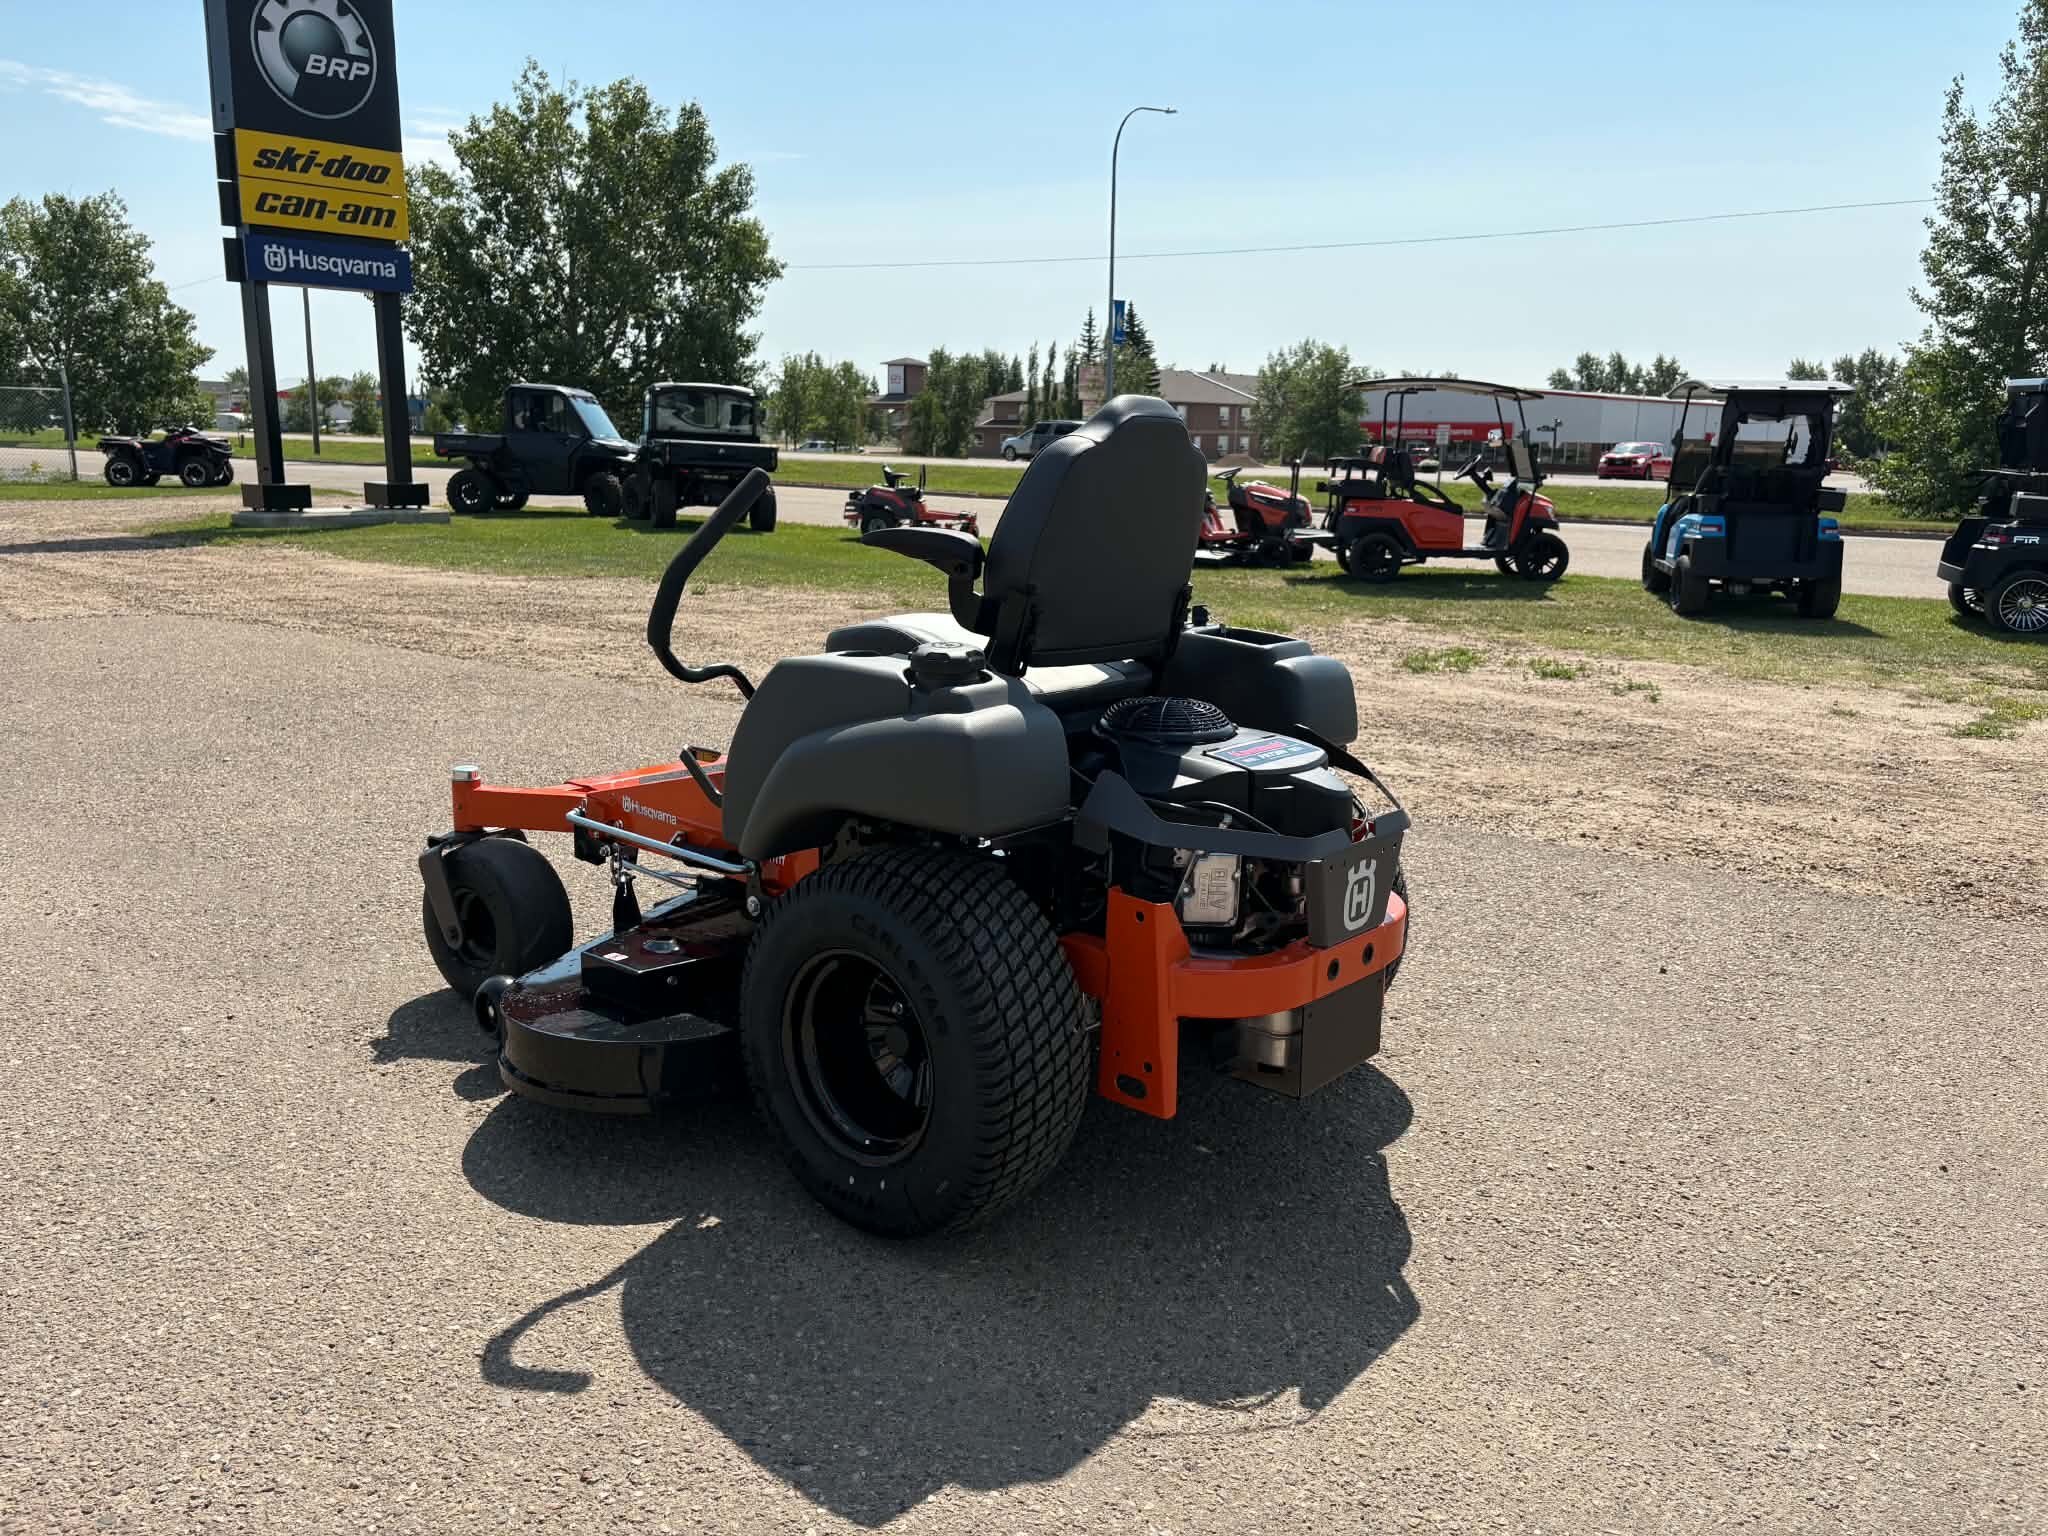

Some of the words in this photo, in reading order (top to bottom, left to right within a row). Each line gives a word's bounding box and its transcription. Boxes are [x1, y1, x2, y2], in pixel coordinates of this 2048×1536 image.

[305, 54, 370, 81] BRP
[253, 146, 391, 185] ski-doo
[255, 191, 396, 229] can-am
[289, 248, 397, 278] Husqvarna
[631, 802, 677, 826] Husqvarna
